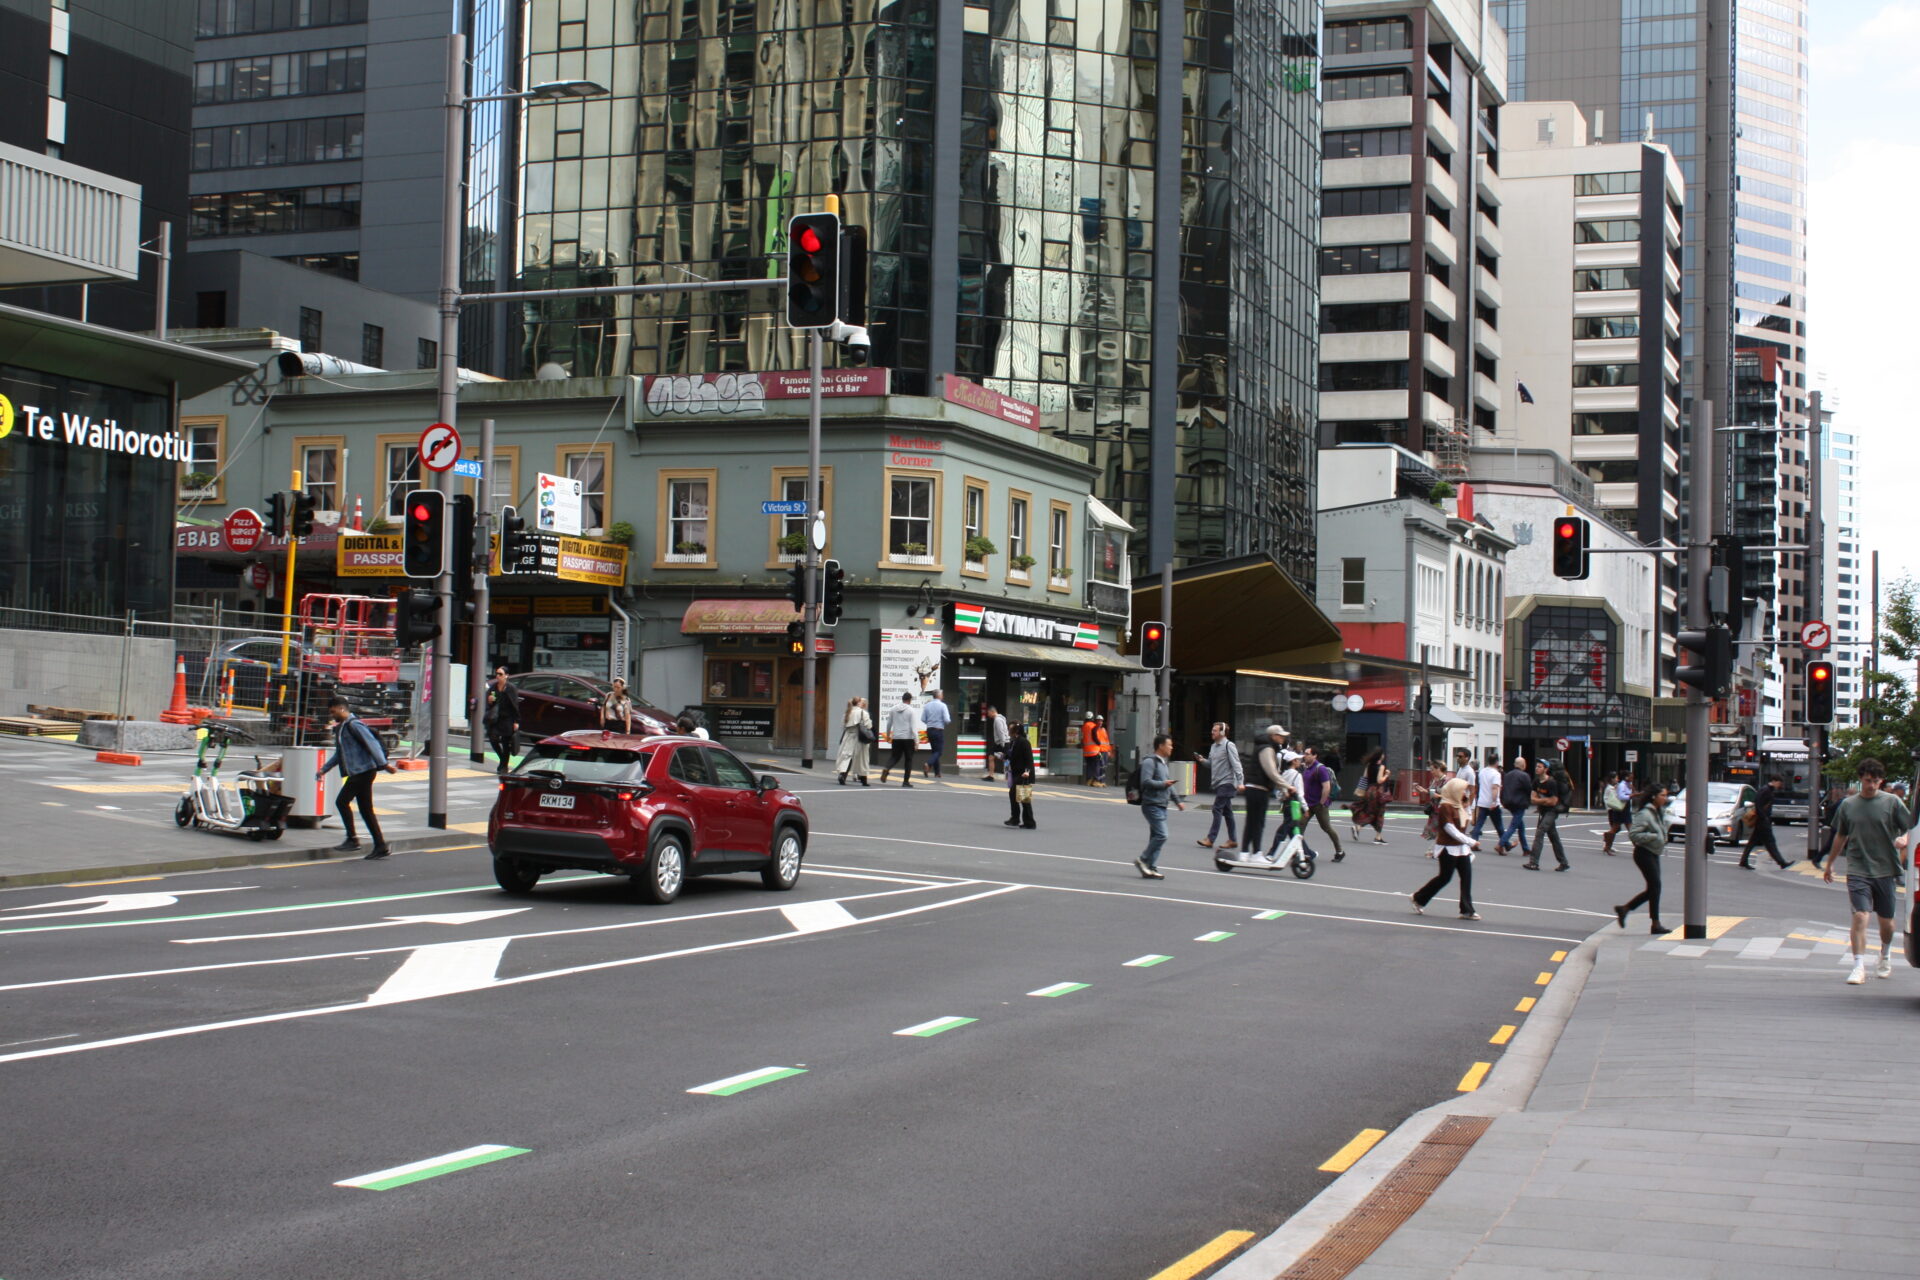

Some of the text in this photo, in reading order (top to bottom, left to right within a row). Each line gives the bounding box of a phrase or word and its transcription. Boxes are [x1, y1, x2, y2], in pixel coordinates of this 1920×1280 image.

[835, 375, 868, 383] Cuisine
[787, 384, 861, 394] Restaant & Bar
[22, 404, 193, 463] Te Waihorotiu
[889, 434, 944, 451] Marthas
[892, 452, 933, 467] Corner
[469, 463, 476, 475] St
[767, 503, 801, 512] Victoria St
[230, 528, 256, 536] BURGER
[177, 531, 220, 547] EBAB
[344, 537, 390, 550] DIGITAL
[391, 539, 399, 550] &
[541, 544, 558, 555] PHOTO
[562, 540, 583, 554] DIGITAL
[588, 543, 599, 556] FILM
[600, 546, 624, 561] SERVICES
[354, 553, 404, 565] PASSPO
[541, 556, 557, 567] IMAGE
[563, 556, 621, 575] PASSPORT PHOTOS
[984, 610, 1056, 640] SKYMART
[541, 795, 573, 807] RKM134
